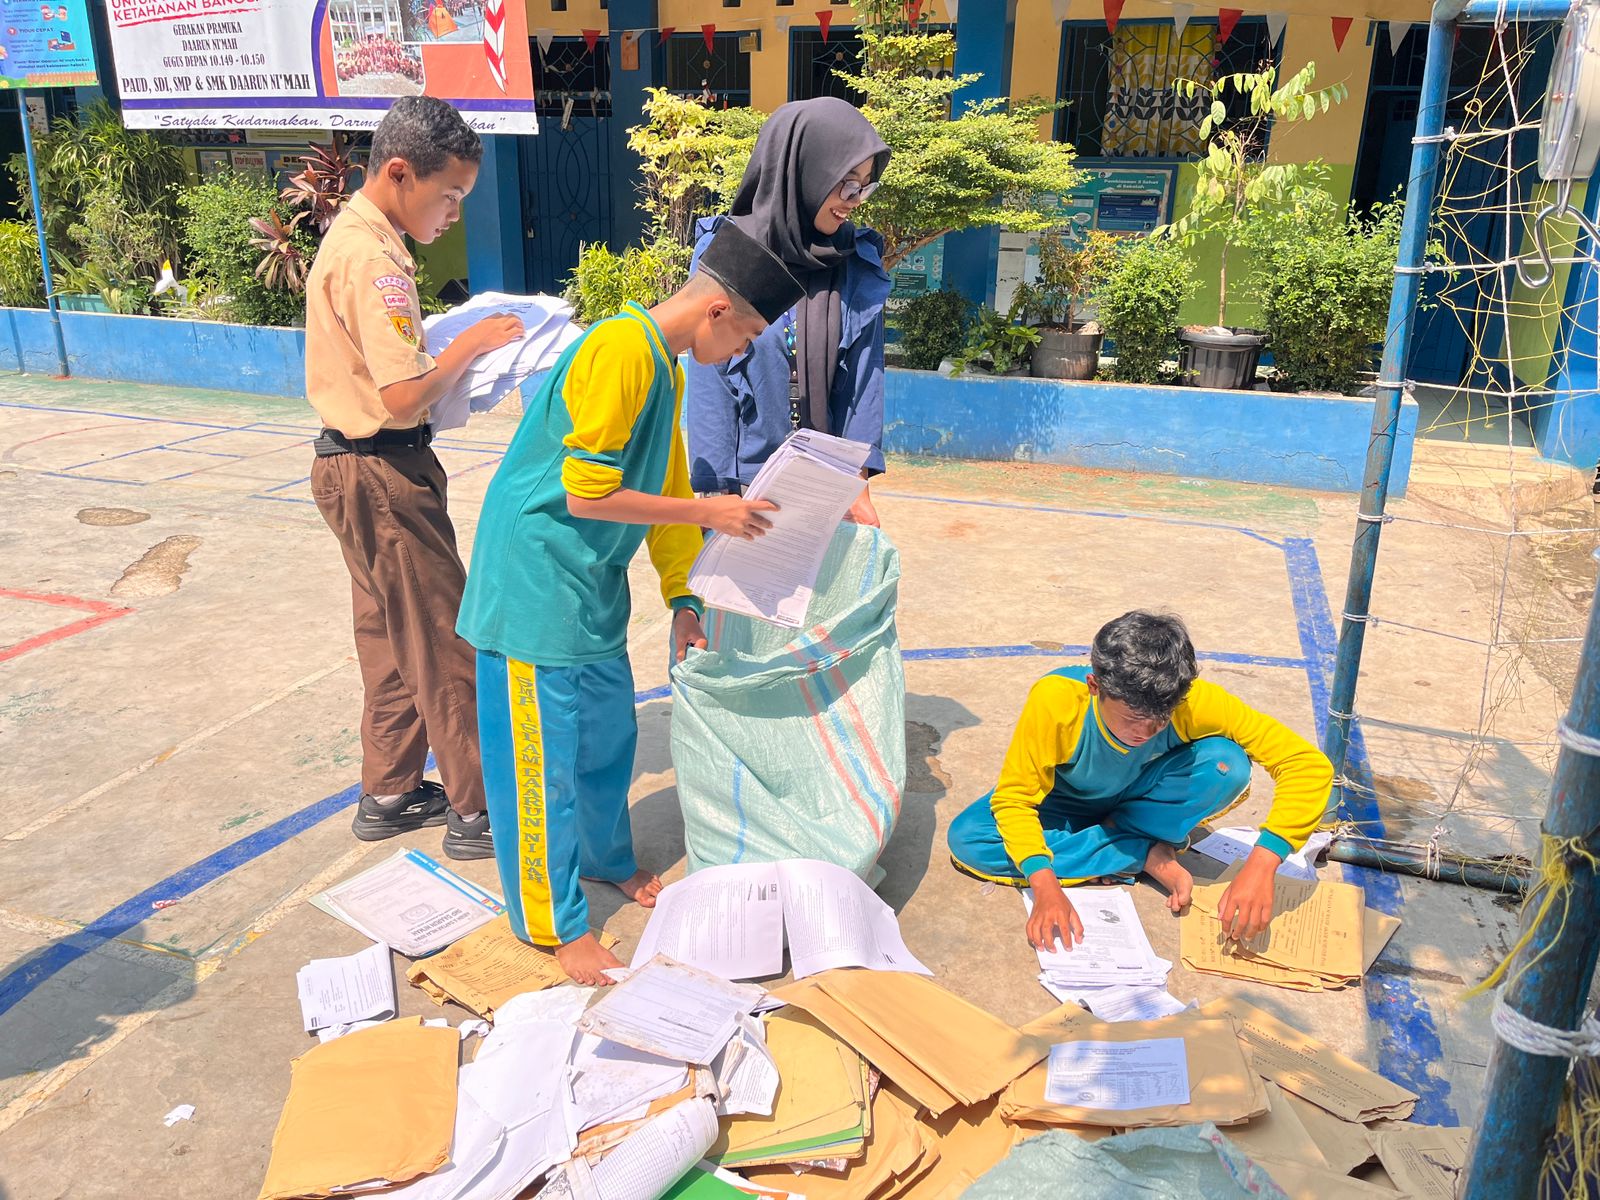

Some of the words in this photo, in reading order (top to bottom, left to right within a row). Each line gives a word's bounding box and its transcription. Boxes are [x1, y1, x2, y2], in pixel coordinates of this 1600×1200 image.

[113, 0, 197, 21] KETAHANAN
[173, 23, 205, 35] GERAKAN
[207, 22, 243, 34] PRAMUKA
[182, 39, 211, 51] DAARUN
[213, 38, 238, 50] NI'MAH
[163, 56, 184, 67] GUGUS
[185, 55, 208, 66] DEPAN
[209, 55, 234, 66] 10.149
[241, 54, 265, 65] 10.150
[122, 77, 152, 93] PAUD,
[154, 77, 172, 93] SDI,
[174, 76, 192, 91] SMP
[195, 77, 204, 90] &
[207, 75, 227, 91] SMK
[229, 74, 268, 91] DAARUN
[270, 74, 311, 90] NI'MAH
[520, 714, 541, 766] ISLAM
[522, 768, 542, 828] DAARUN
